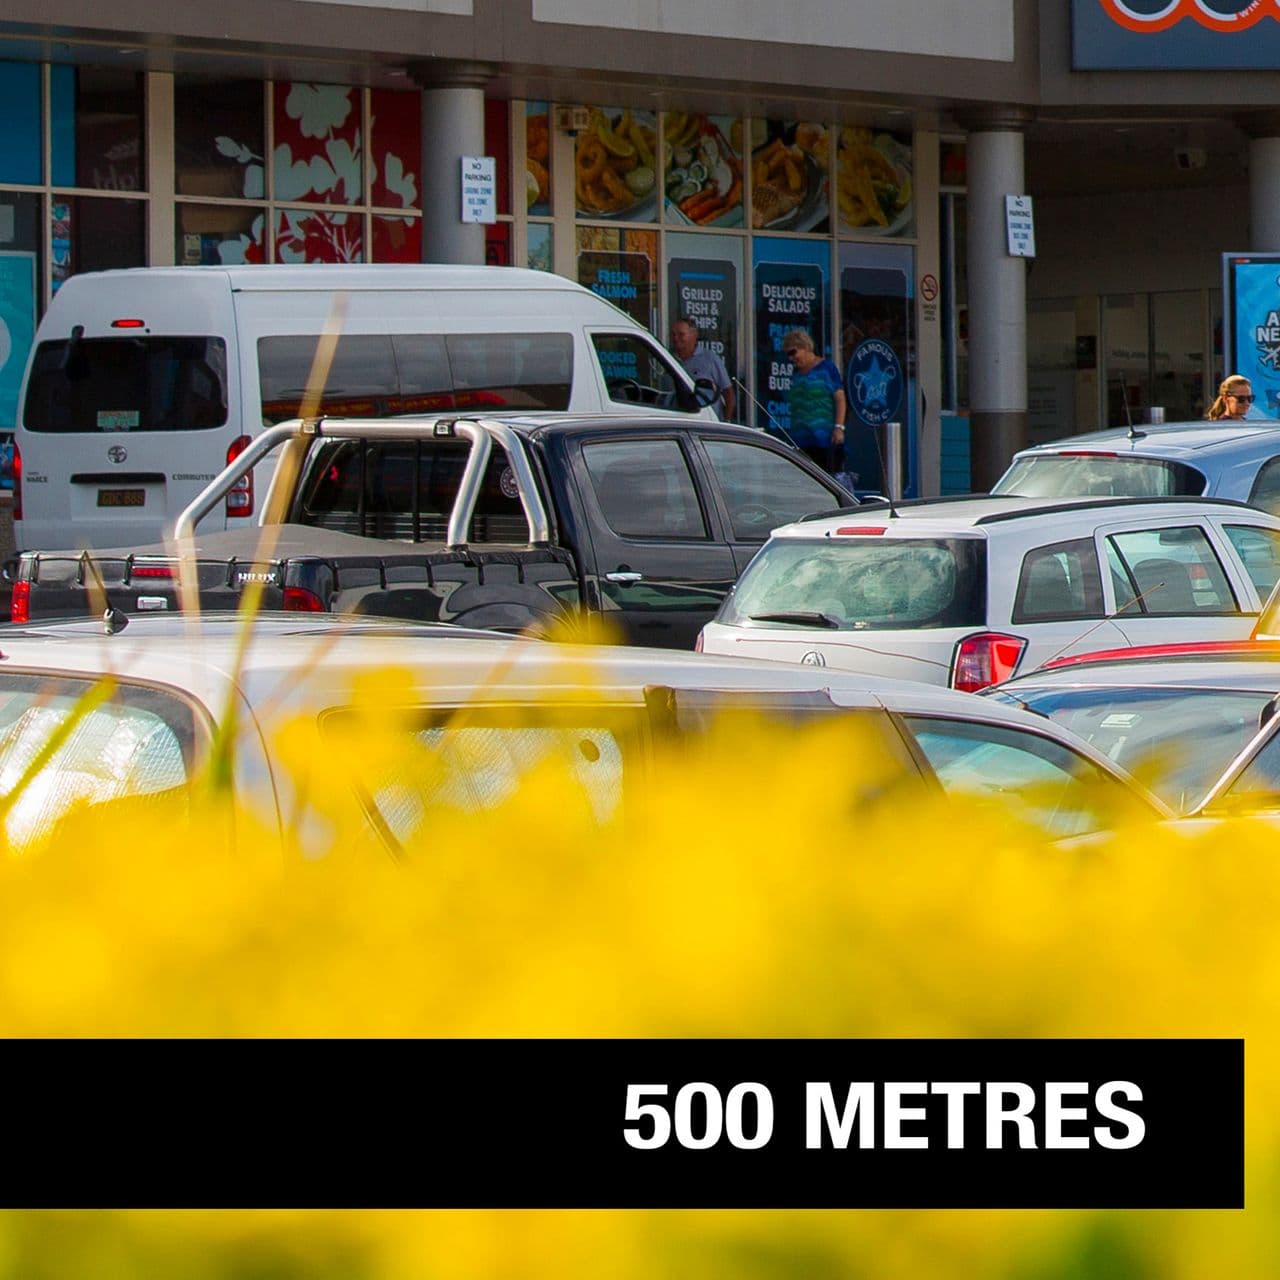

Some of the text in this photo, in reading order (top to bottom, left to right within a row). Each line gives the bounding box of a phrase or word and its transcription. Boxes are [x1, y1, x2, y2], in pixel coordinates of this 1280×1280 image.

[597, 271, 631, 283] FRESH
[592, 284, 637, 299] SALMON
[682, 287, 723, 302] GRILLED
[762, 284, 816, 300] DELICIOUS
[686, 303, 719, 316] FISH &
[768, 299, 811, 314] SALADS
[1267, 312, 1280, 326] A
[600, 352, 637, 363] OOKED
[857, 343, 892, 361] FAMOUS
